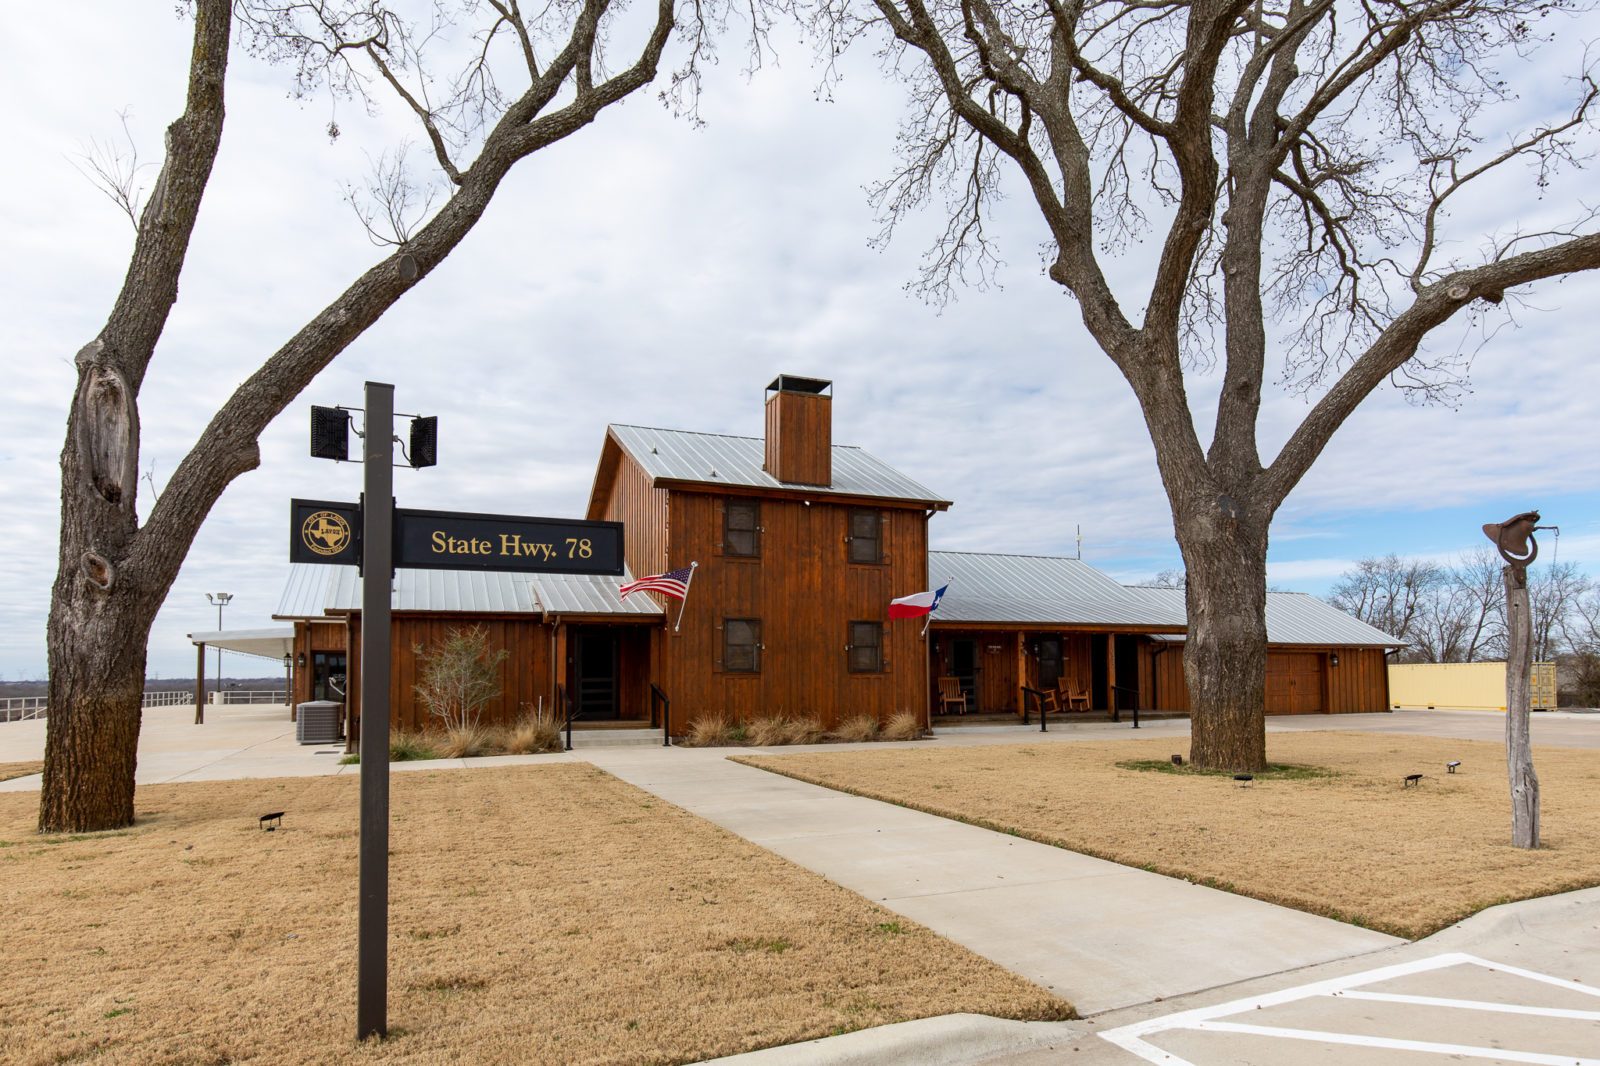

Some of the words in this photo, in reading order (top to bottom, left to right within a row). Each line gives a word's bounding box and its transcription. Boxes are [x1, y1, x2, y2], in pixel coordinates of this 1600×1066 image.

[431, 530, 493, 554] State
[498, 534, 557, 562] Hwy.
[565, 538, 592, 559] 78
